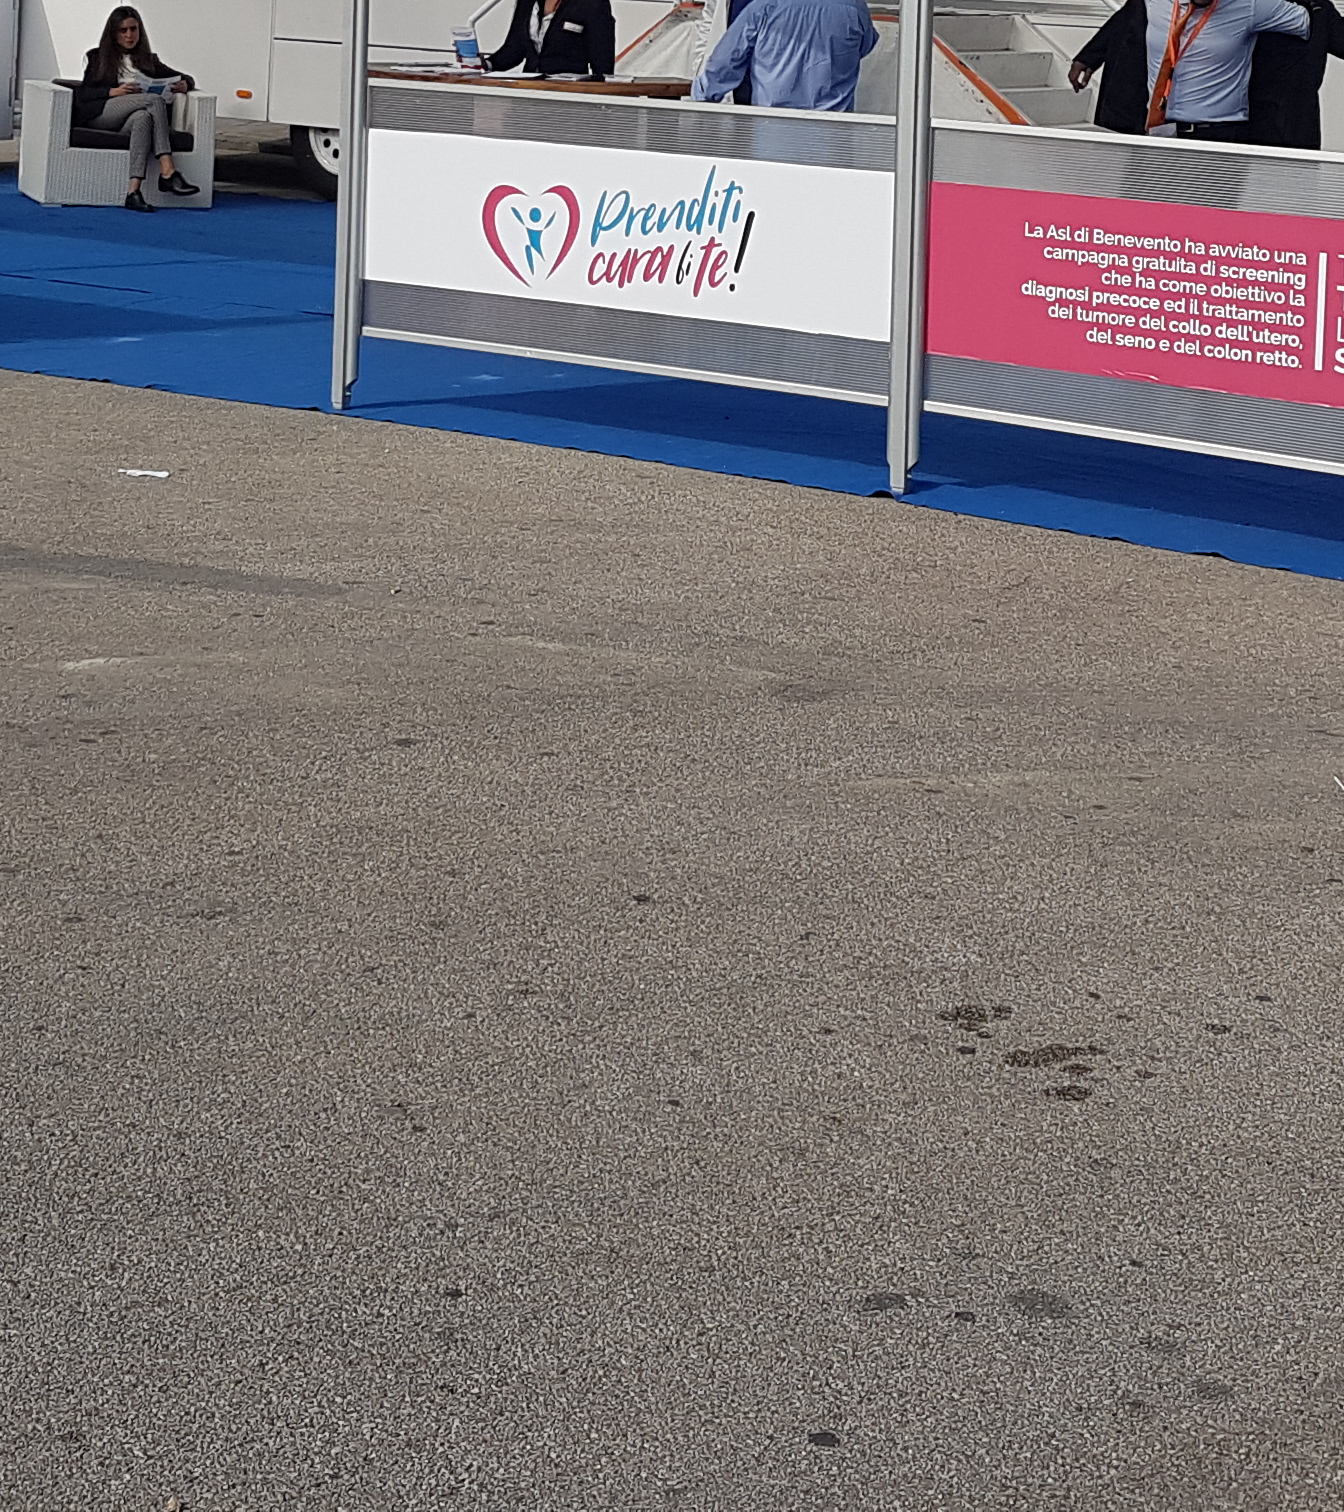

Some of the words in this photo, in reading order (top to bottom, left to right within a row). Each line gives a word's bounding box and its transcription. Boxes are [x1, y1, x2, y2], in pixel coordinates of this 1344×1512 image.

[591, 165, 743, 247] Prenditi
[1024, 222, 1043, 238] La
[1046, 225, 1071, 240] Asl
[1074, 227, 1089, 242] di
[1093, 229, 1181, 252] Benevento
[1185, 238, 1205, 254] ha
[1209, 243, 1270, 261] avviato
[1274, 251, 1306, 265] una
[588, 244, 674, 288] cura
[1044, 246, 1128, 268] campagna
[1132, 256, 1196, 274] gratuita
[1200, 260, 1215, 276] di
[1220, 268, 1306, 290] screening
[1102, 270, 1132, 286] che
[1136, 273, 1155, 289] ha
[1159, 279, 1207, 295] come
[1210, 282, 1285, 304] obiettivo
[1289, 290, 1305, 306] la
[1021, 280, 1089, 301] diagnosi
[1092, 290, 1160, 310] precoce
[1164, 298, 1186, 313] ed
[1190, 299, 1199, 314] il
[1202, 301, 1304, 327] trattamento
[1048, 303, 1072, 319] dei
[1076, 306, 1135, 327] tumore
[1139, 314, 1166, 331] del
[1169, 319, 1211, 336] collo
[1215, 323, 1303, 349] dell'utero,
[1086, 327, 1112, 344] del
[1115, 333, 1156, 350] seno
[1159, 339, 1170, 351] e
[1174, 338, 1201, 355] del
[1204, 344, 1252, 362] colon
[1256, 350, 1302, 368] retto.
